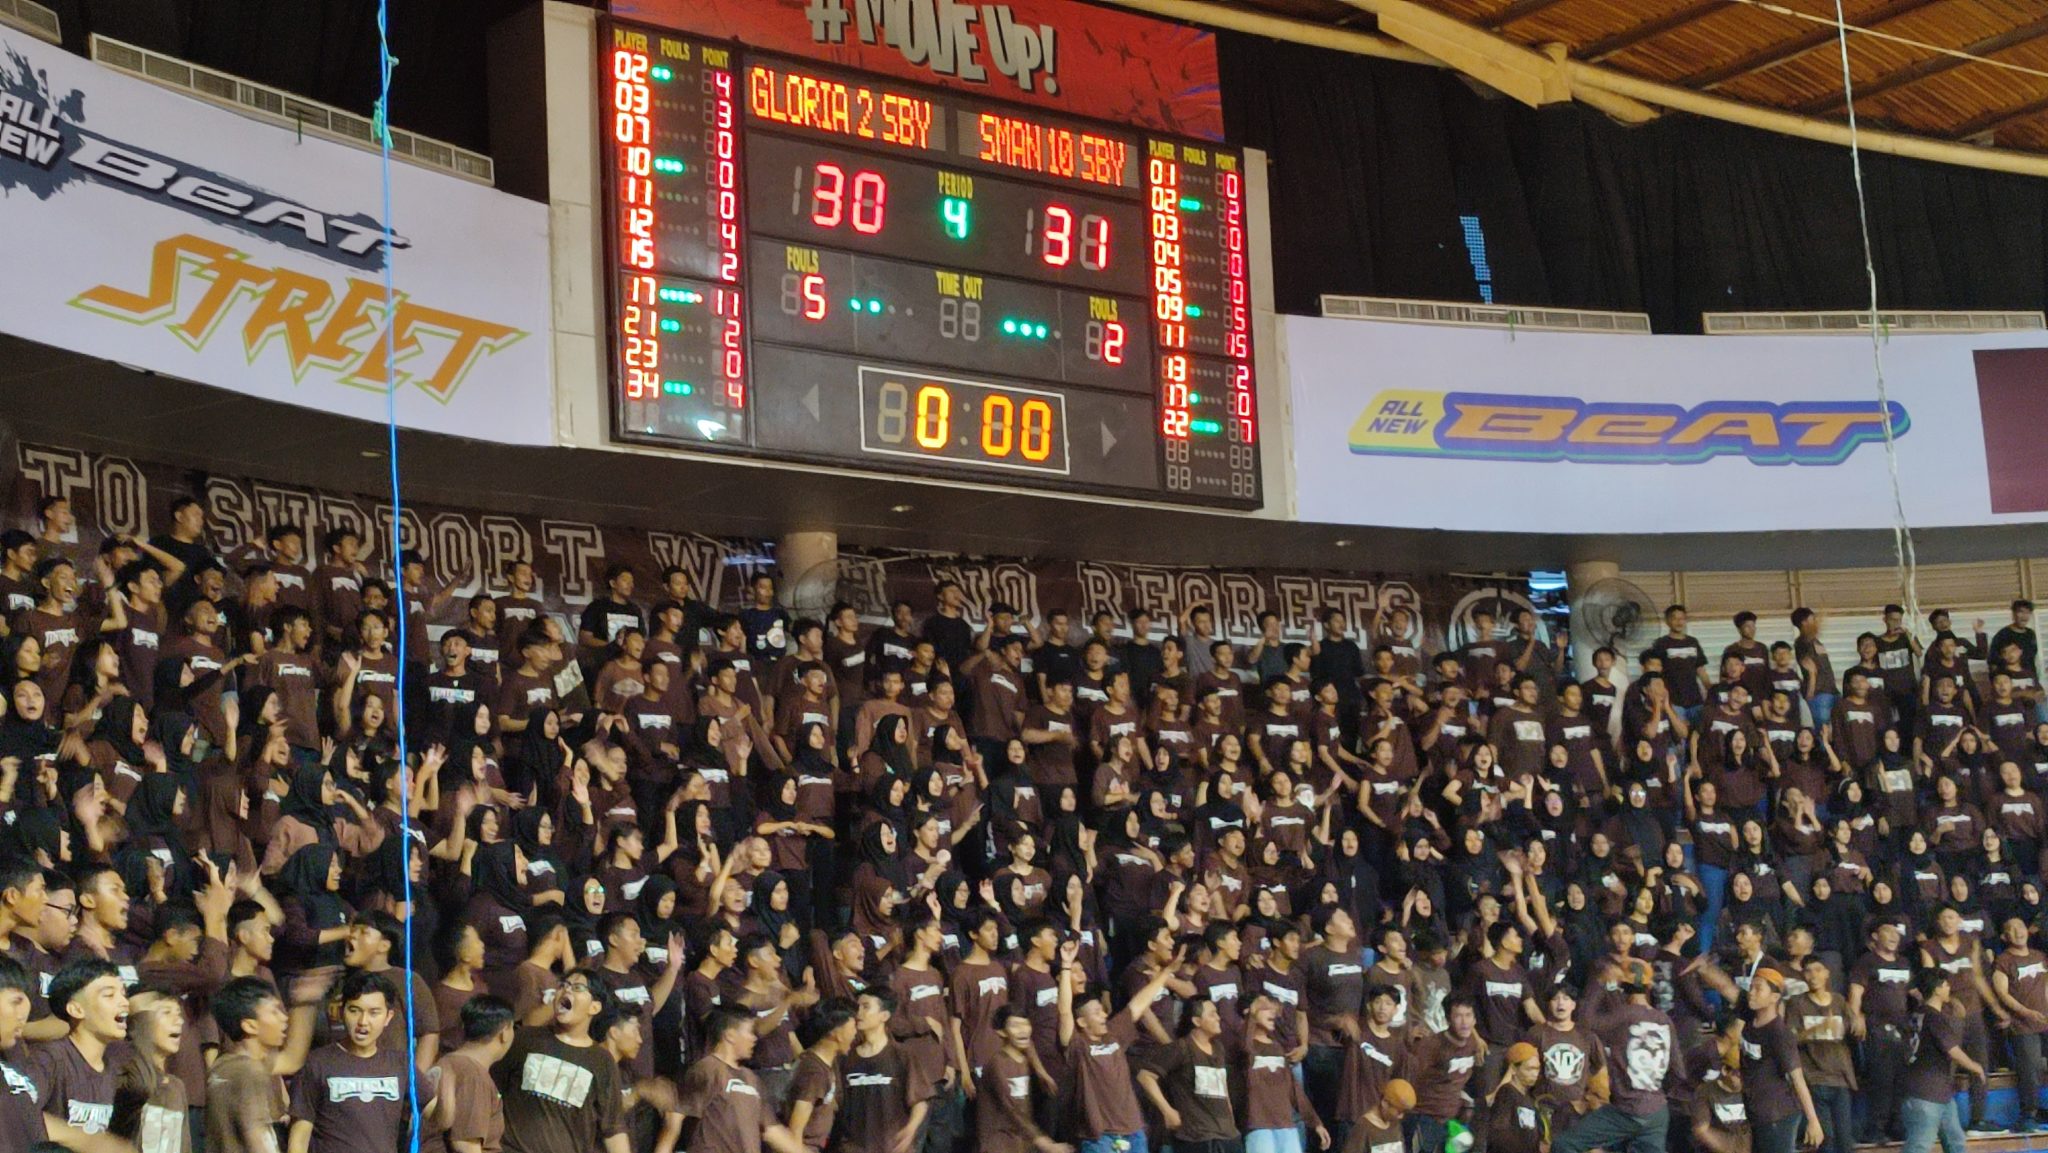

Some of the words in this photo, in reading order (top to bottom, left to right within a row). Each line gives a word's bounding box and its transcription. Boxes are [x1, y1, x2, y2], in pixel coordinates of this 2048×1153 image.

[614, 28, 648, 53] PLAYER
[660, 37, 690, 61] FOULS
[702, 46, 729, 68] POINT
[614, 51, 648, 83] 02
[716, 71, 730, 98] 4
[0, 91, 61, 138] ALL
[615, 83, 649, 114] 03
[718, 100, 732, 129] 3
[752, 67, 850, 135] GLORIA
[857, 89, 875, 139] 2
[881, 93, 931, 149] SBY
[0, 120, 61, 165] EW
[616, 115, 649, 144] 07
[718, 131, 733, 160] 0
[979, 113, 1042, 172] SMAN
[1049, 128, 1075, 178] 10
[1081, 134, 1128, 187] SBY
[1149, 139, 1176, 160] PLAYER
[1183, 145, 1207, 167] FOULS
[1215, 152, 1237, 171] POINT
[627, 147, 650, 176] 10
[719, 161, 734, 189] 0
[938, 171, 974, 200] PERIOD
[1150, 159, 1175, 185] 01
[1225, 173, 1239, 198] 0
[628, 178, 652, 206] 11
[720, 191, 735, 220] 0
[813, 164, 886, 235] 30
[943, 198, 968, 239] 4
[1151, 186, 1176, 213] 02
[1227, 200, 1240, 223] 2
[629, 208, 653, 239] 12
[722, 223, 737, 250] 4
[1044, 206, 1108, 269] 31
[1153, 213, 1178, 240] 03
[1229, 227, 1241, 251] 0
[630, 239, 654, 269] 15
[722, 255, 738, 282] 2
[786, 246, 820, 273] FOULS
[1154, 240, 1179, 266] 04
[1231, 253, 1243, 278] 0
[632, 276, 656, 305] 17
[716, 288, 739, 317] 11
[803, 275, 826, 320] 5
[935, 270, 960, 298] TIME
[963, 275, 983, 301] OUT
[1156, 266, 1182, 293] 05
[1232, 280, 1244, 305] 0
[66, 232, 532, 405] STREET
[625, 305, 657, 336] 21
[724, 319, 741, 348] 2
[1089, 296, 1118, 321] FOULS
[1157, 294, 1183, 321] 09
[1233, 307, 1246, 331] 5
[625, 337, 658, 368] 23
[726, 350, 742, 379] 0
[1104, 322, 1124, 364] 2
[1165, 324, 1185, 348] 11
[1227, 333, 1247, 358] 15
[626, 368, 659, 399] 34
[727, 382, 743, 409] 4
[1167, 355, 1187, 382] 13
[1236, 365, 1249, 390] 2
[1169, 383, 1187, 408] 17
[1237, 392, 1250, 416] 0
[1378, 400, 1424, 417] ALL
[1164, 409, 1189, 437] 22
[1240, 418, 1252, 443] 7
[1366, 417, 1430, 434] NEW
[17, 438, 149, 542] TO
[205, 476, 605, 606] SUPPORT
[926, 562, 1041, 634] NO
[1076, 560, 1424, 650] REGRETS
